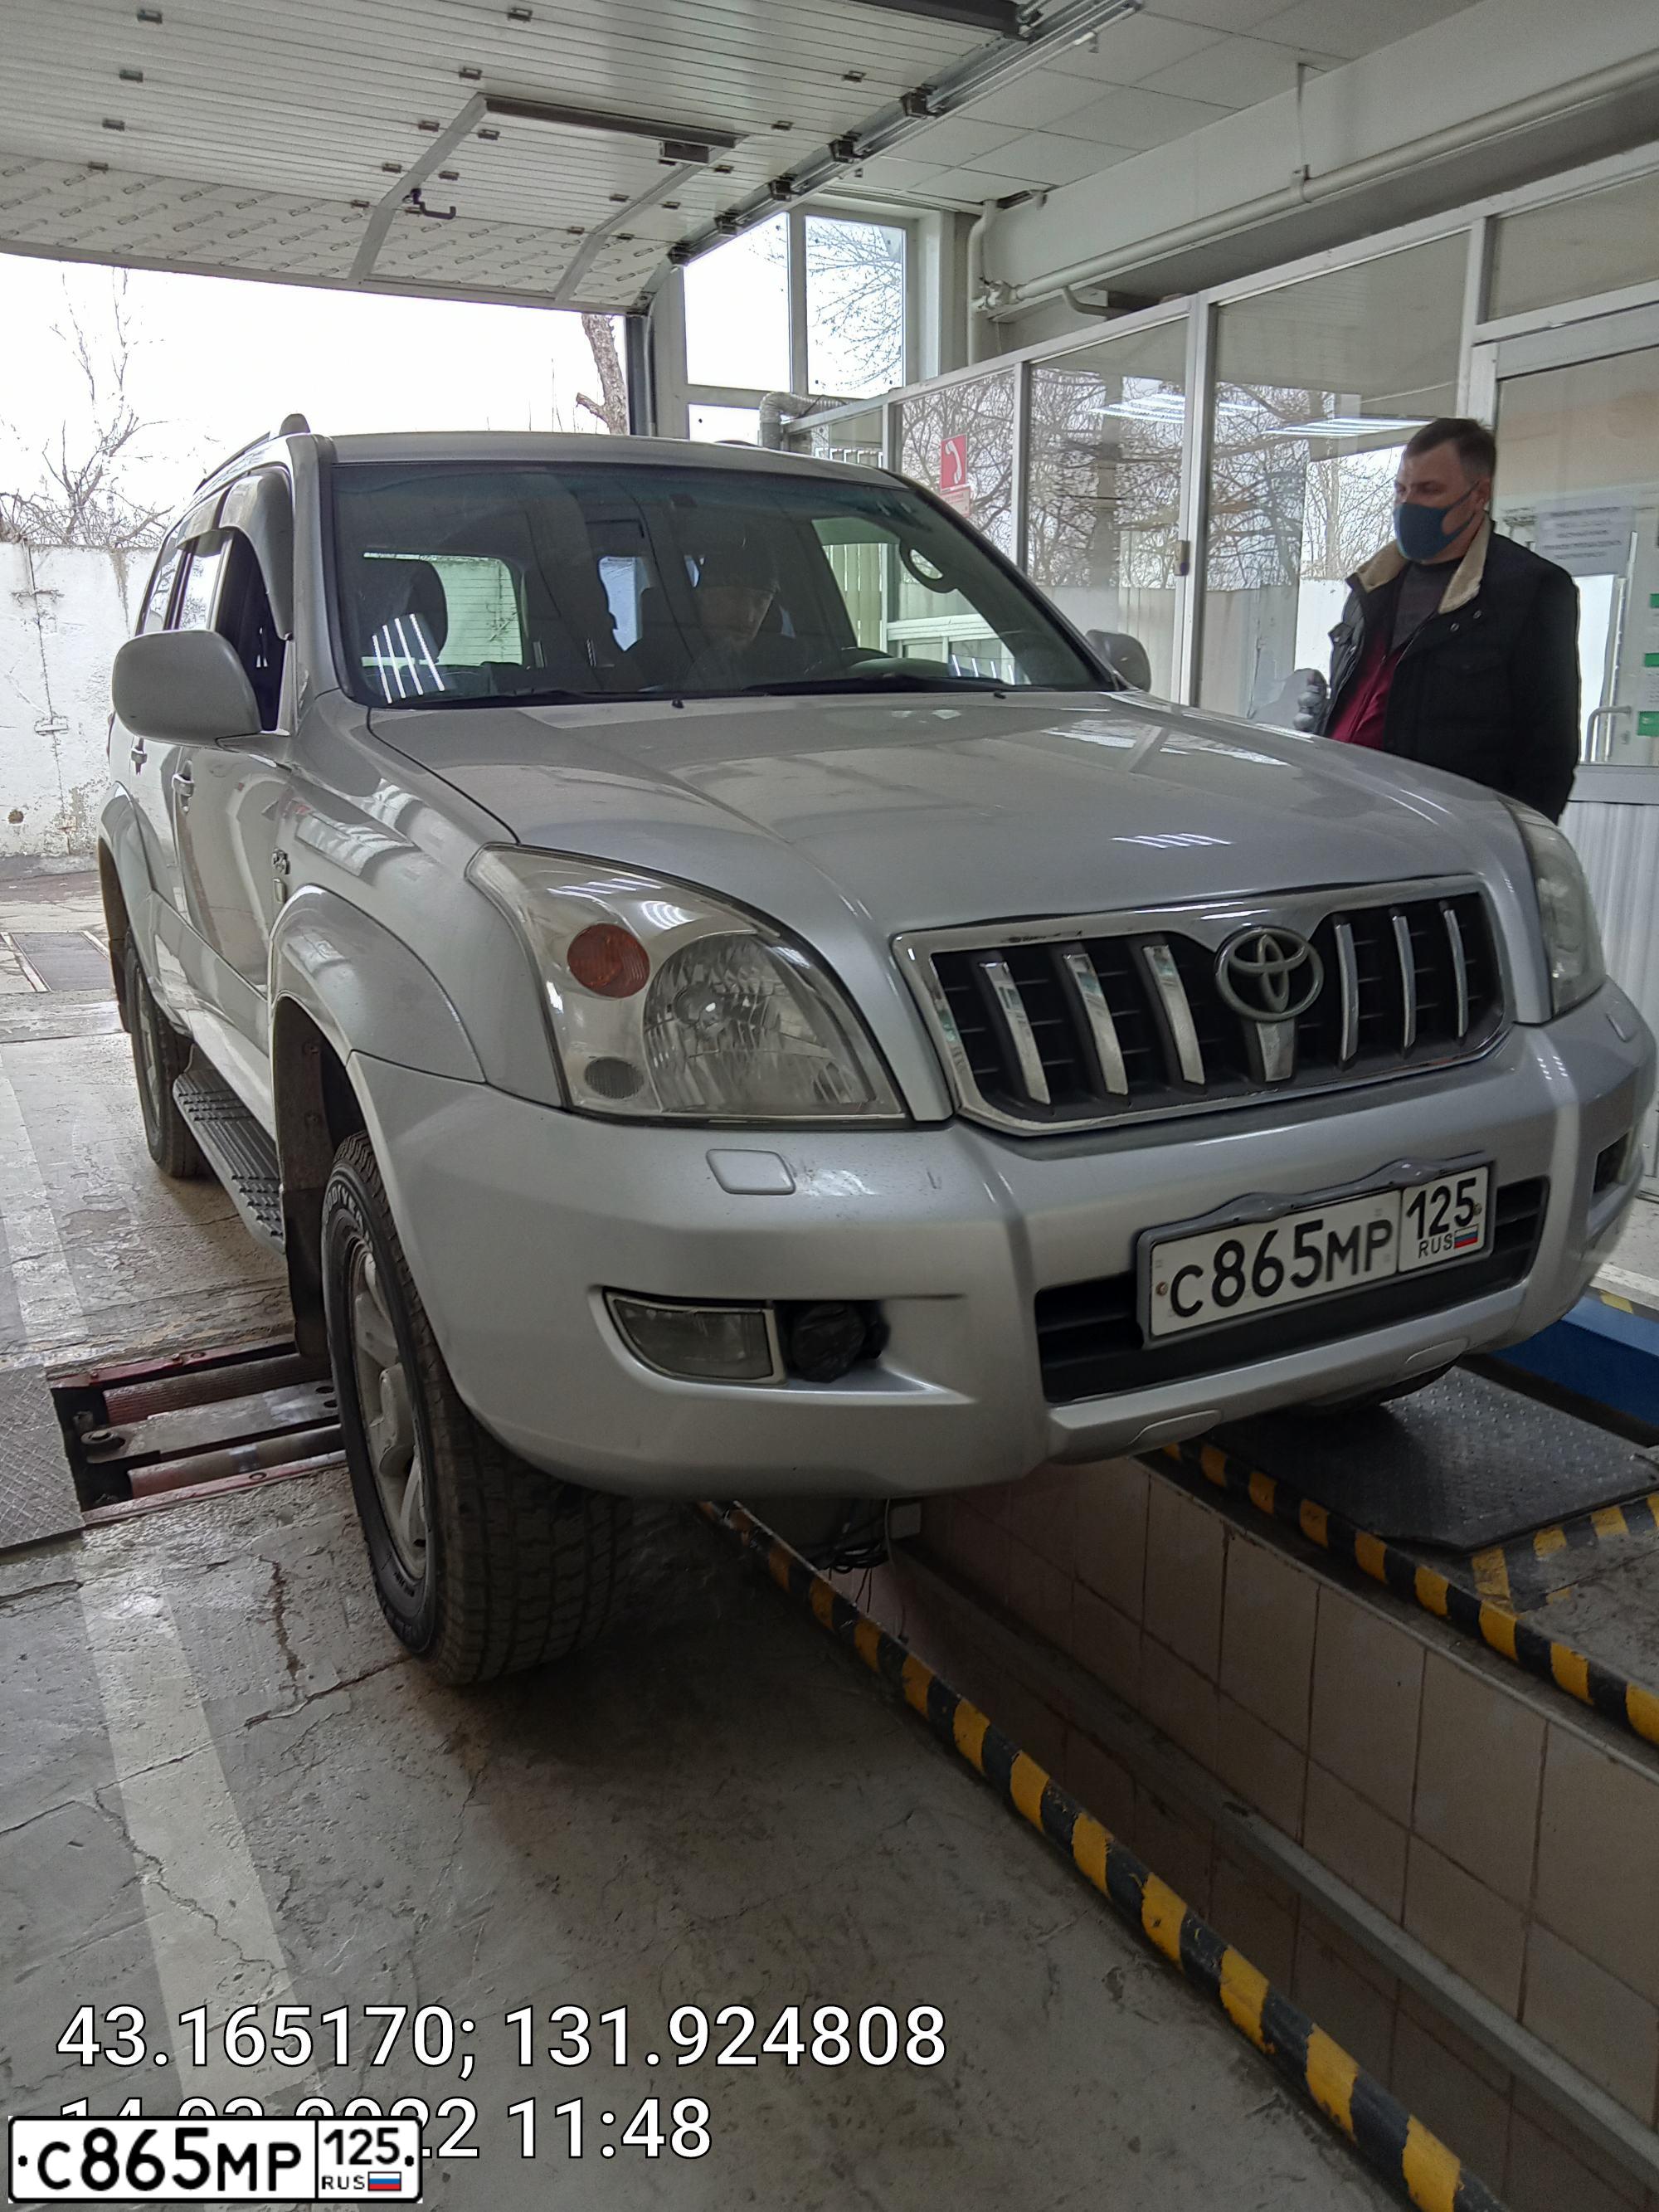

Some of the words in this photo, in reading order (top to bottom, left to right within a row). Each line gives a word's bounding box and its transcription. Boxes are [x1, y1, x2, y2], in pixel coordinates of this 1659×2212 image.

[1170, 1219, 1393, 1318] С865МР
[1405, 1177, 1477, 1240] 125
[1418, 1233, 1453, 1259] RUS
